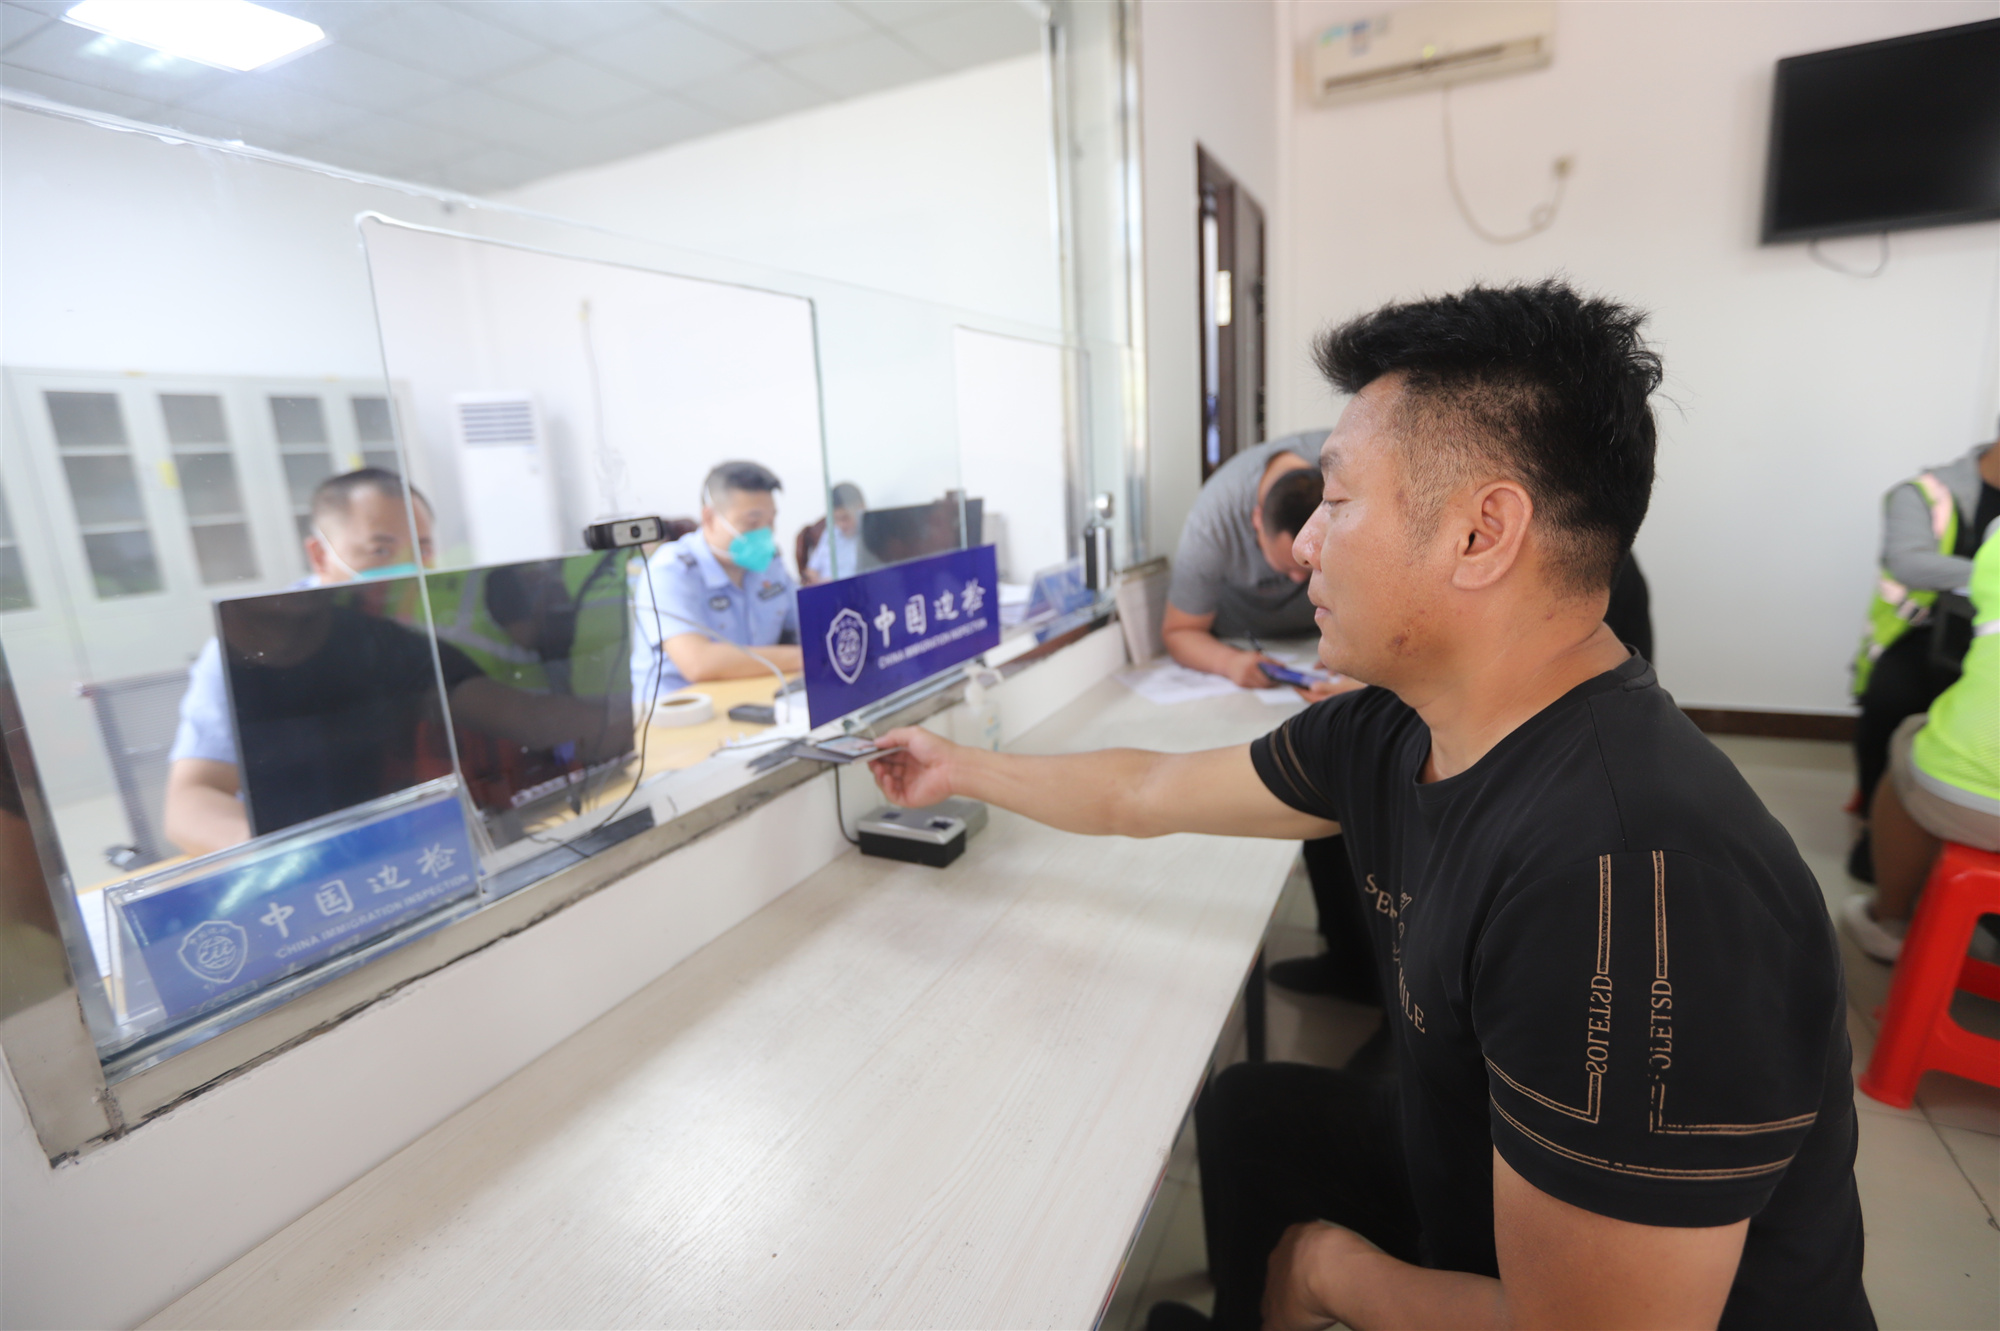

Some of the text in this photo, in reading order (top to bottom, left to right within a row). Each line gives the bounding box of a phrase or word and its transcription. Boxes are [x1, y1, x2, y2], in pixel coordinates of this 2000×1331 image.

[873, 577, 987, 649] 中国边检
[259, 842, 457, 939] 中国边检
[275, 933, 321, 959] CHINA
[320, 898, 403, 941] IMMIGRATION
